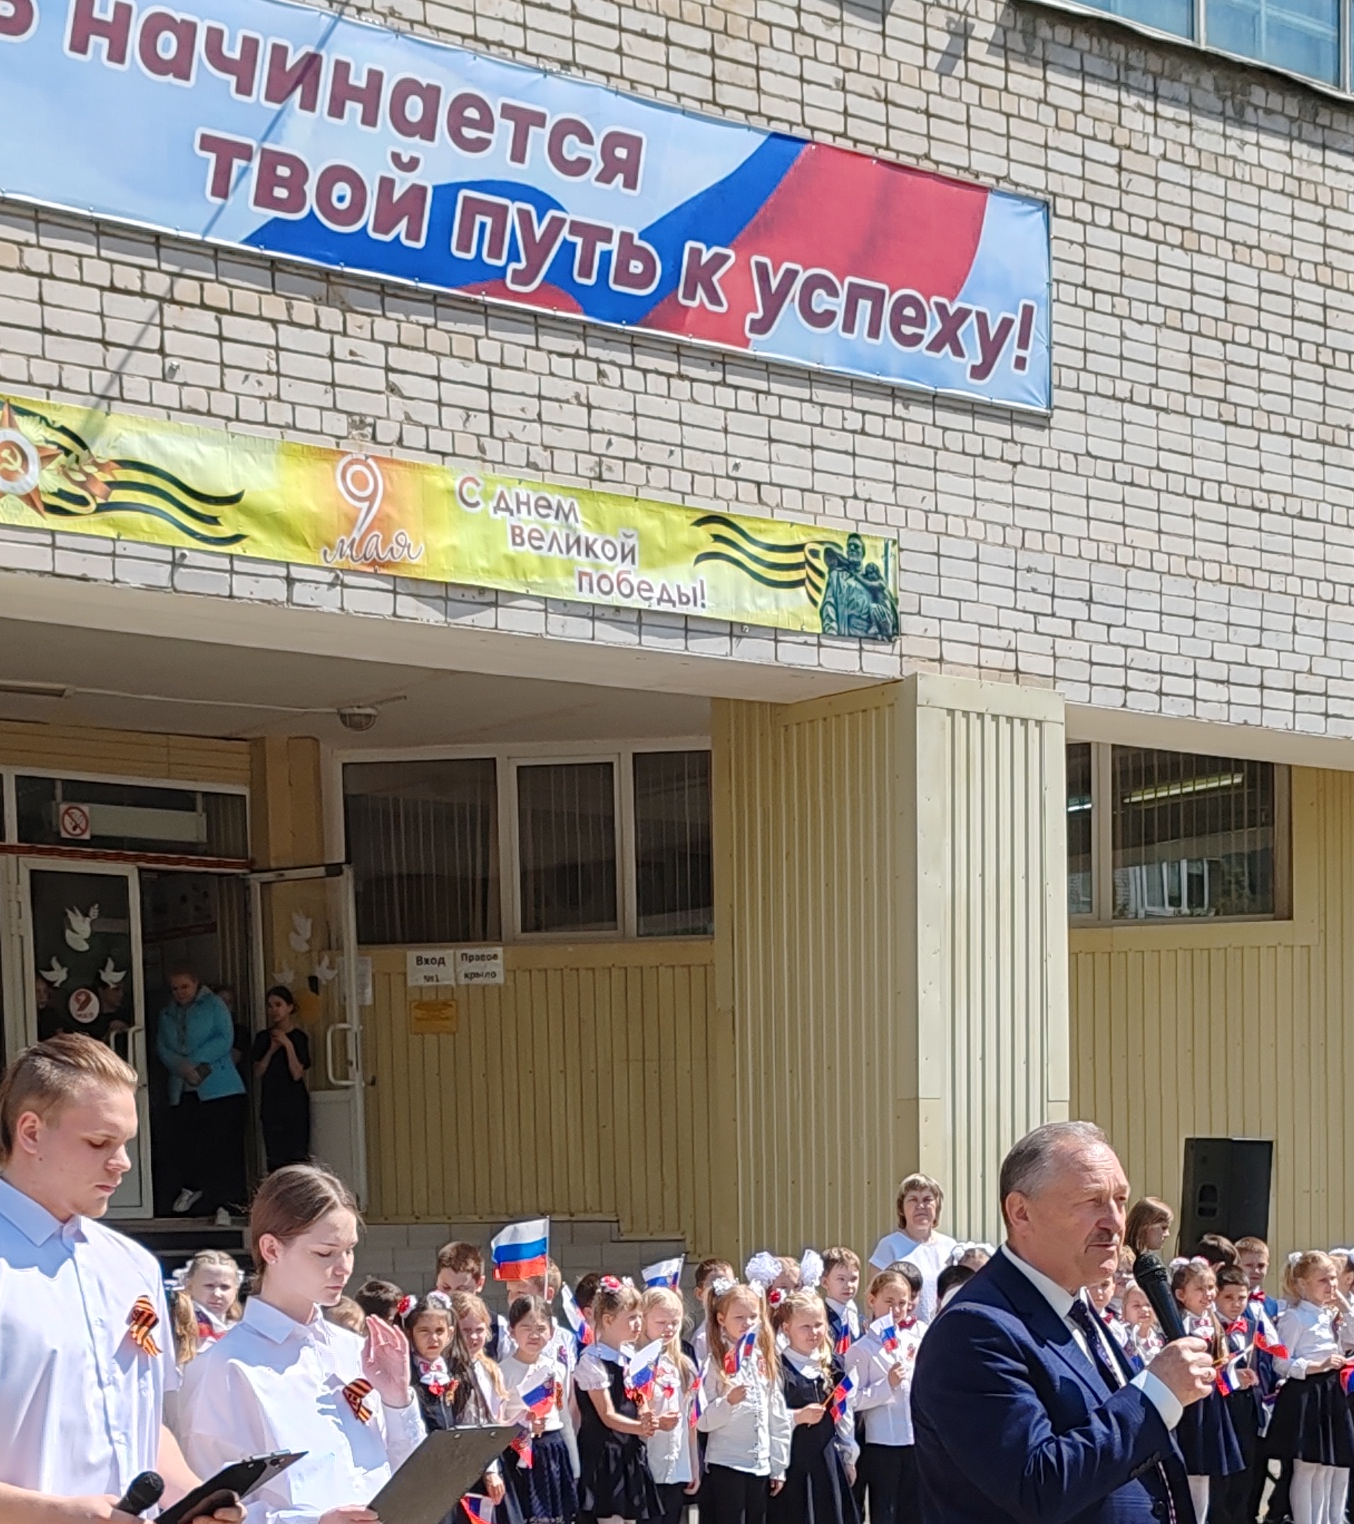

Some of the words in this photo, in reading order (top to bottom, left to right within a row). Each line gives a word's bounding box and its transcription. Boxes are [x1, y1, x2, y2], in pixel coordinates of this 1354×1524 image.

[67, 0, 643, 191] начинается
[199, 133, 429, 244] твой
[456, 194, 657, 290] путь
[683, 245, 733, 308] к
[748, 261, 1036, 380] успеху!
[337, 454, 384, 539] 9
[457, 476, 481, 509] С
[493, 486, 579, 524] днем
[322, 531, 423, 565] мая
[510, 523, 638, 565] великой
[576, 569, 707, 609] победы!
[416, 955, 446, 966] Вход
[460, 952, 498, 964] Правое
[463, 971, 497, 981] крыло
